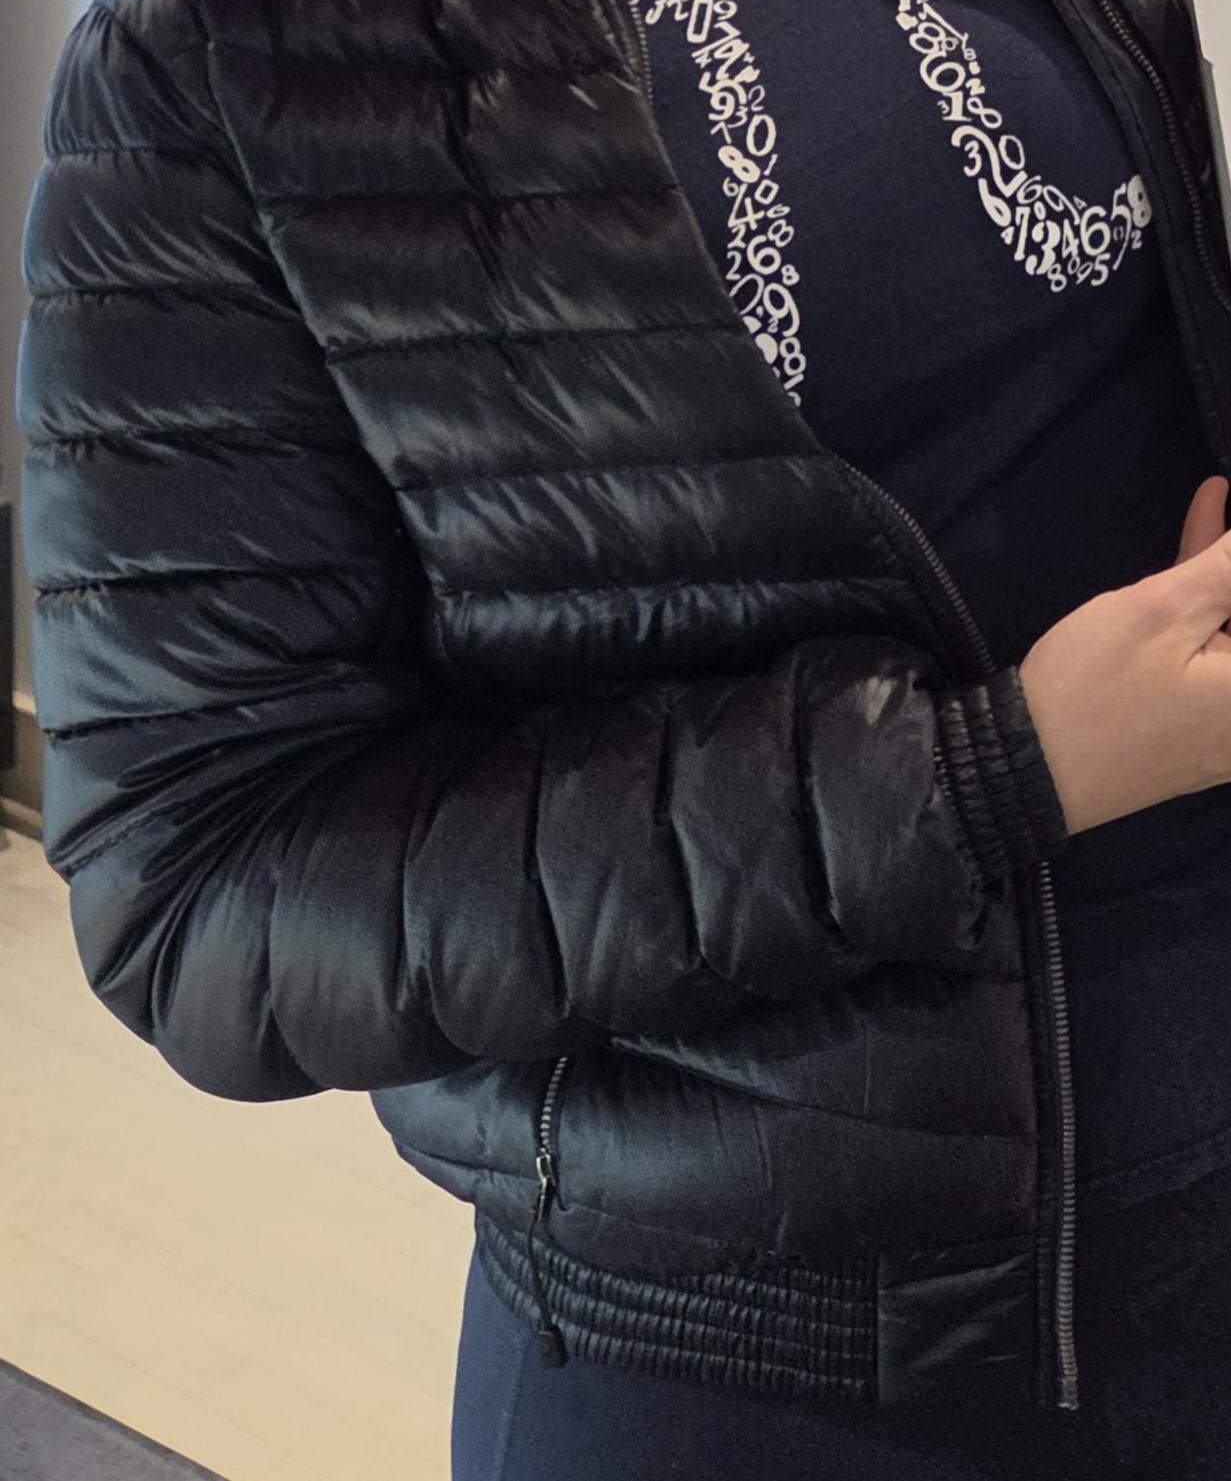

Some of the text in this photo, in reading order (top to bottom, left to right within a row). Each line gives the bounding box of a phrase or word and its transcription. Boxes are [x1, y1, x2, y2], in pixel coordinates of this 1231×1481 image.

[908, 21, 947, 55] 8
[919, 50, 966, 94] 6
[748, 84, 766, 112] 2
[942, 90, 973, 123] 1
[966, 96, 1003, 129] 8
[746, 114, 777, 157] 0
[998, 134, 1026, 171] 0
[718, 144, 761, 184] 8
[951, 124, 1029, 199] 2
[963, 139, 983, 178] 3
[722, 177, 740, 198] 6
[1016, 174, 1043, 205] 6
[727, 183, 766, 231] 4
[767, 218, 795, 248] 8
[1080, 205, 1112, 256] 6
[725, 251, 742, 281] 2
[746, 234, 782, 275] 6
[1090, 252, 1111, 287] 5
[780, 263, 801, 286] 8
[1046, 263, 1068, 293] 8
[762, 282, 801, 337] 9
[778, 336, 807, 377] 8
